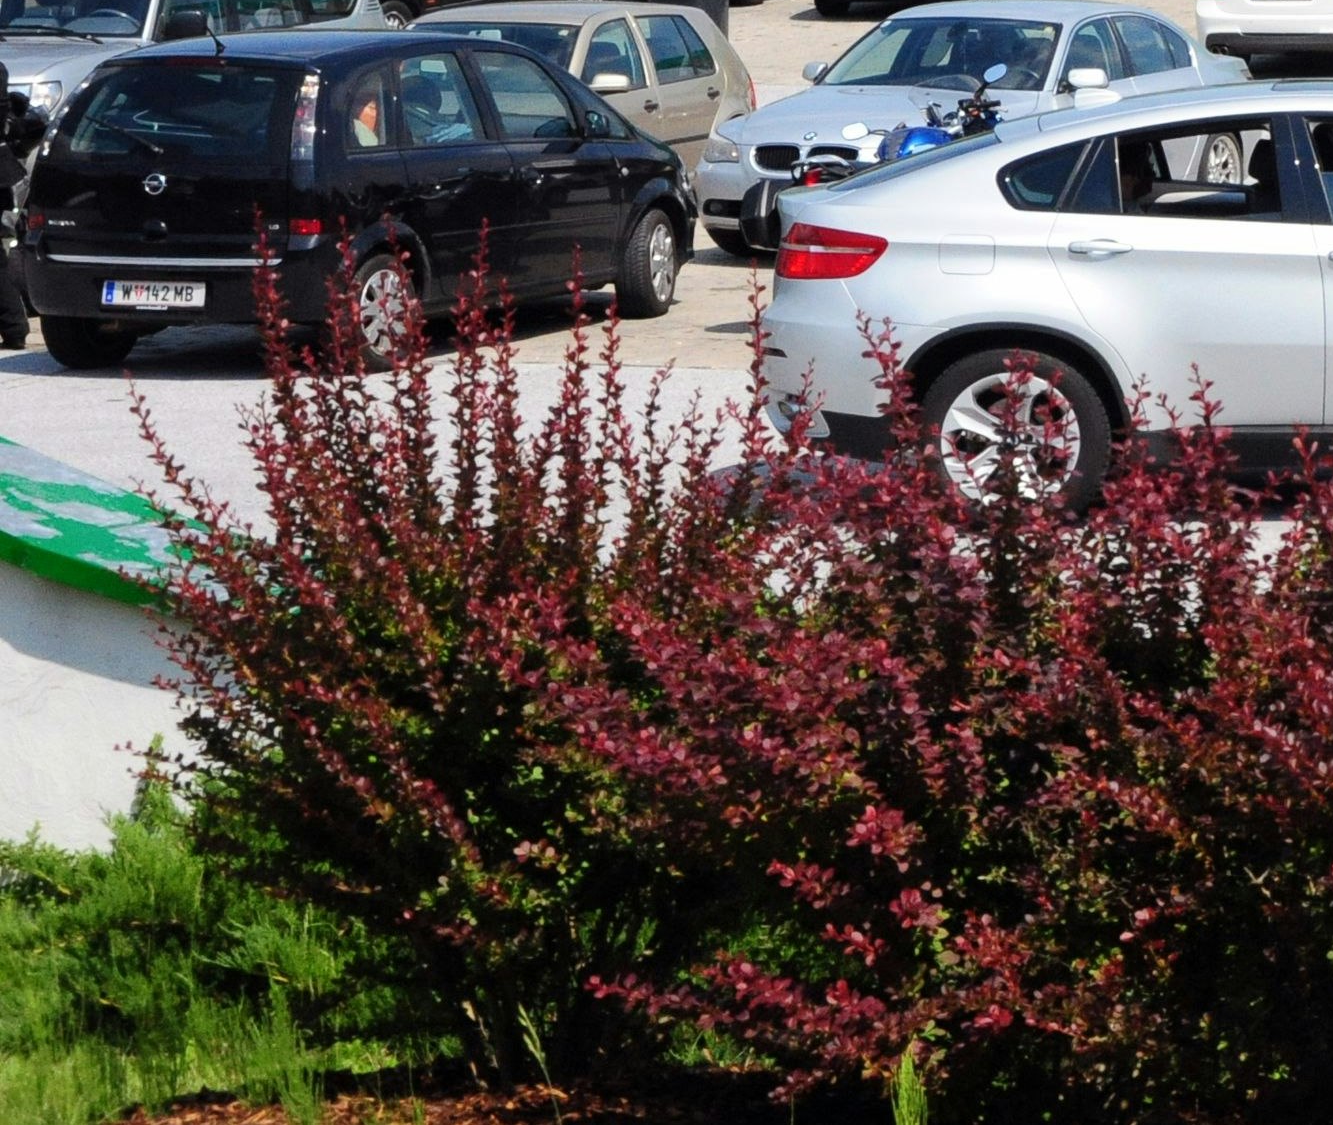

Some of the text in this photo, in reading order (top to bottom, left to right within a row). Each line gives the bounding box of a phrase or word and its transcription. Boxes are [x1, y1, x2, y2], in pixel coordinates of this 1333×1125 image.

[122, 283, 194, 302] W 142 MB
